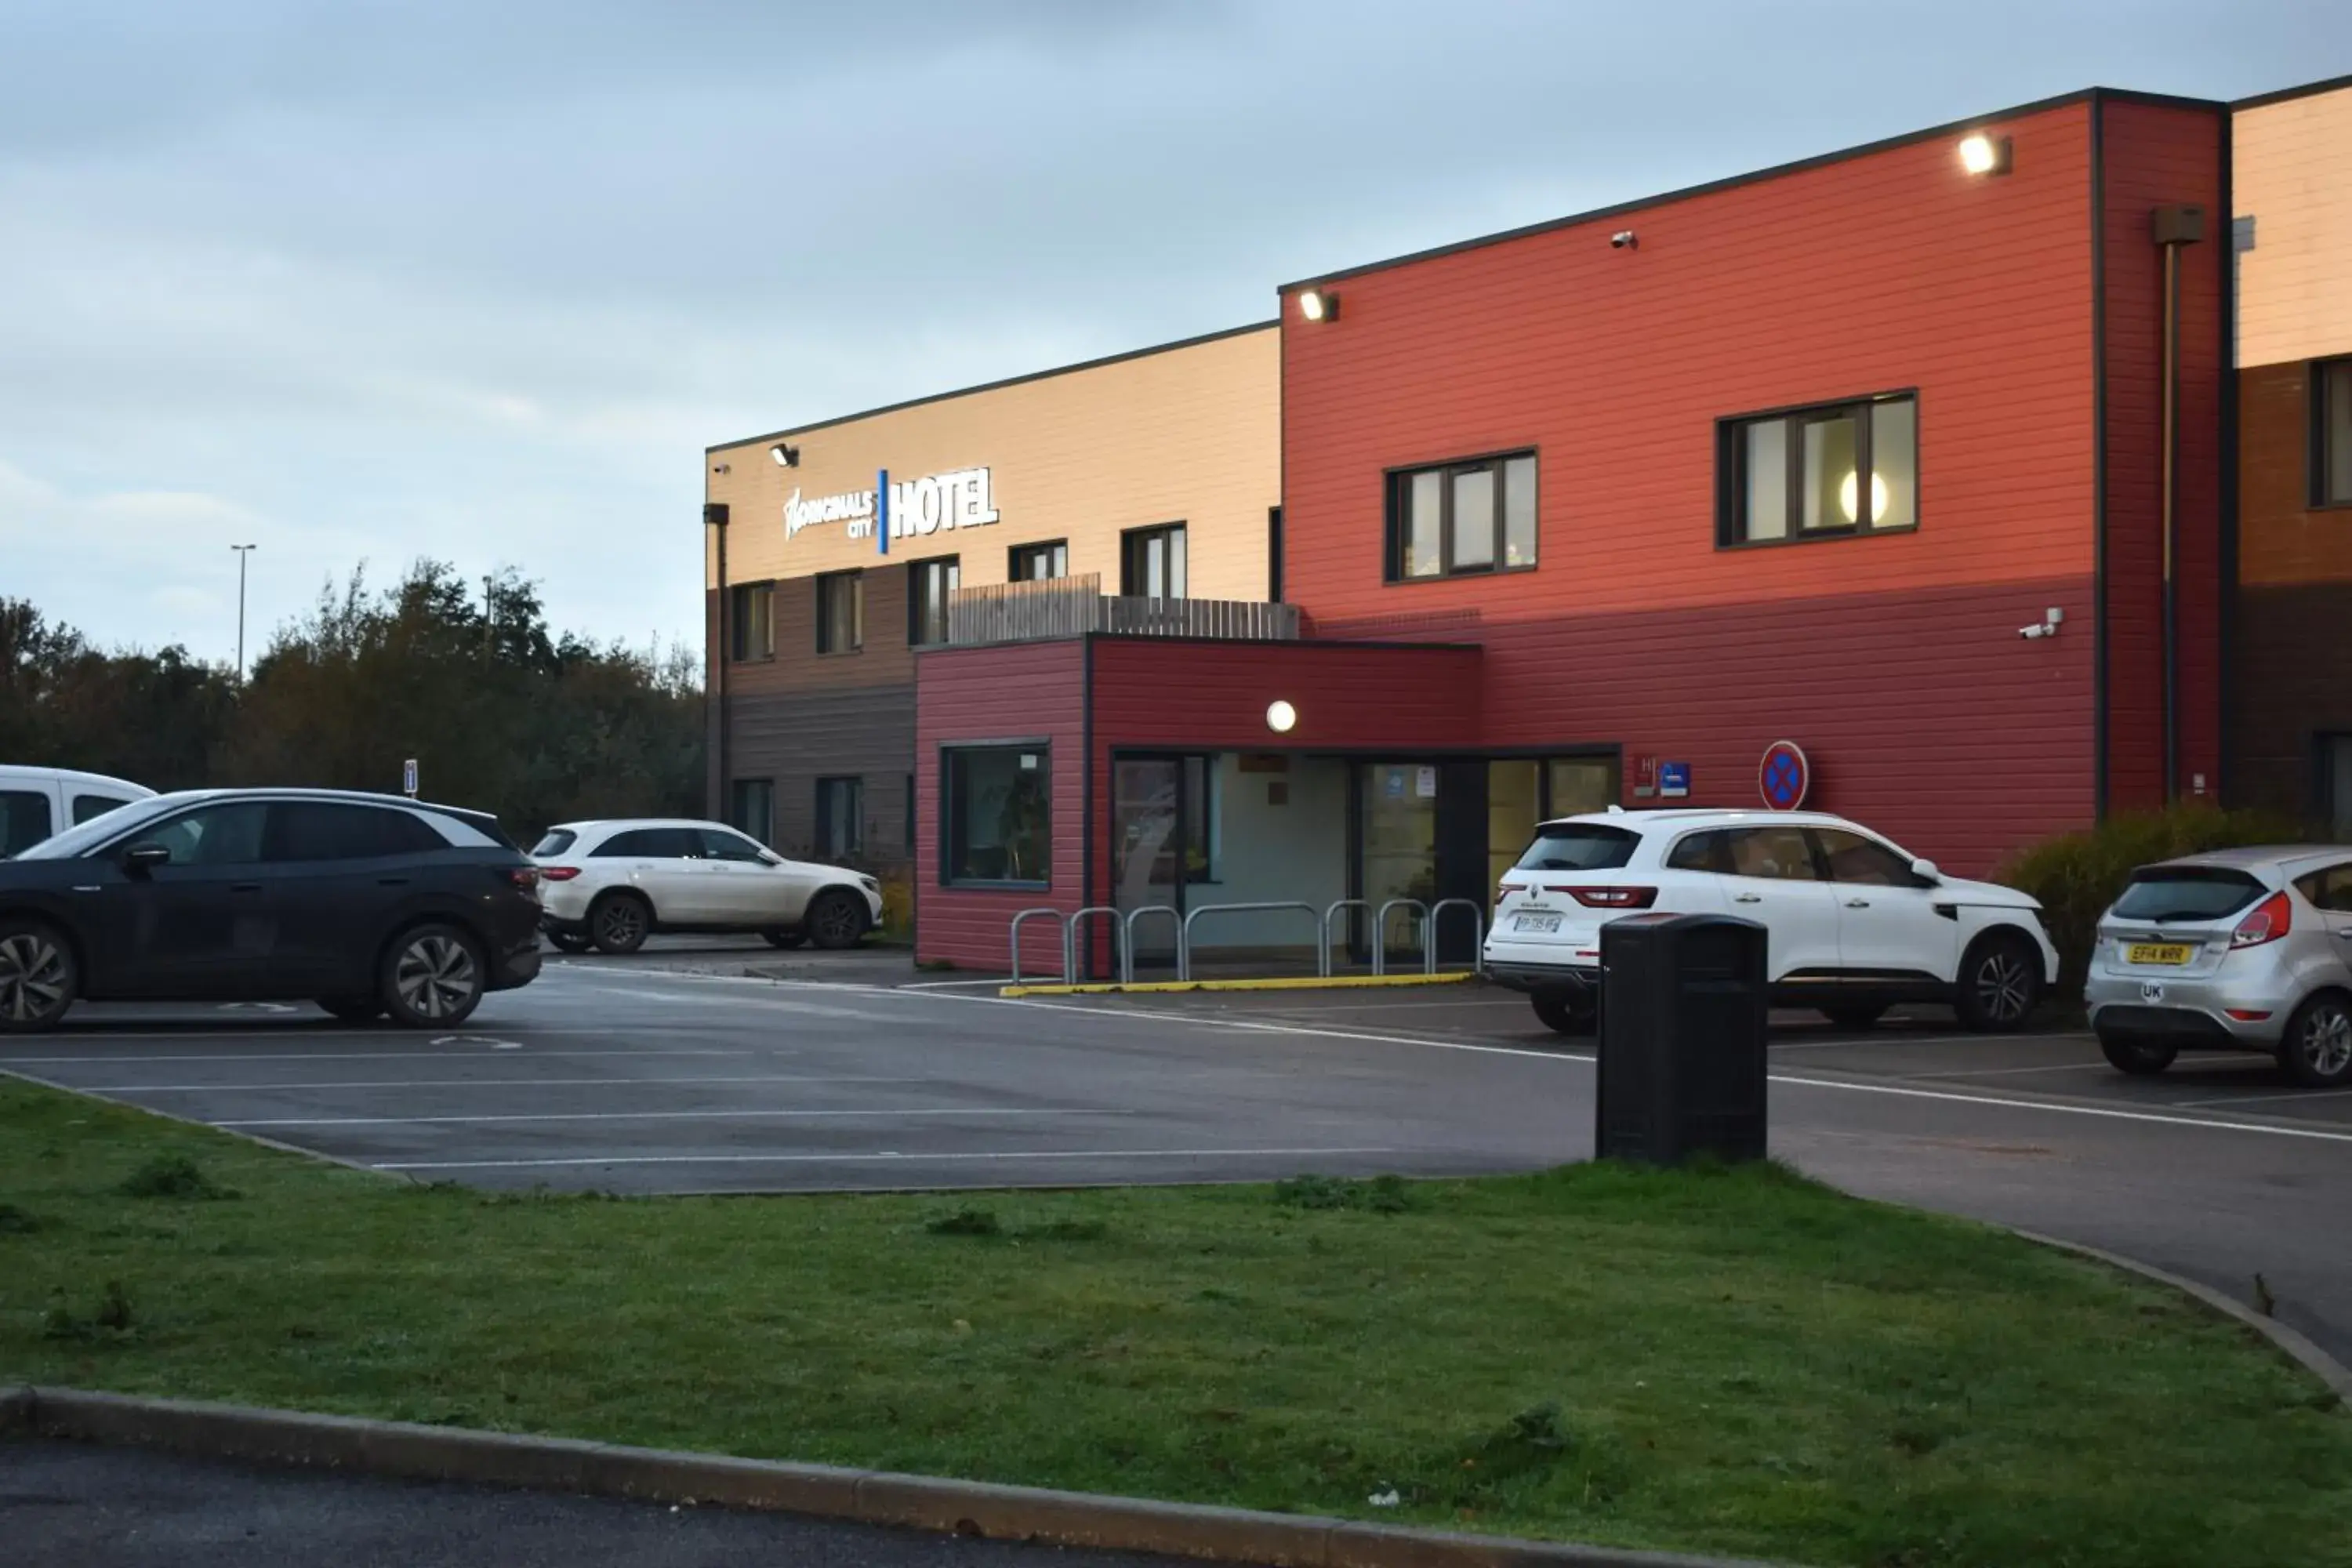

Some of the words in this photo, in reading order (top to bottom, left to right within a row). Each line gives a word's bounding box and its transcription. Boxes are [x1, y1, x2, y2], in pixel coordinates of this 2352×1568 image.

[891, 466, 999, 538] HOTEL
[848, 518, 872, 538] CITY
[2143, 985, 2161, 998] UK
